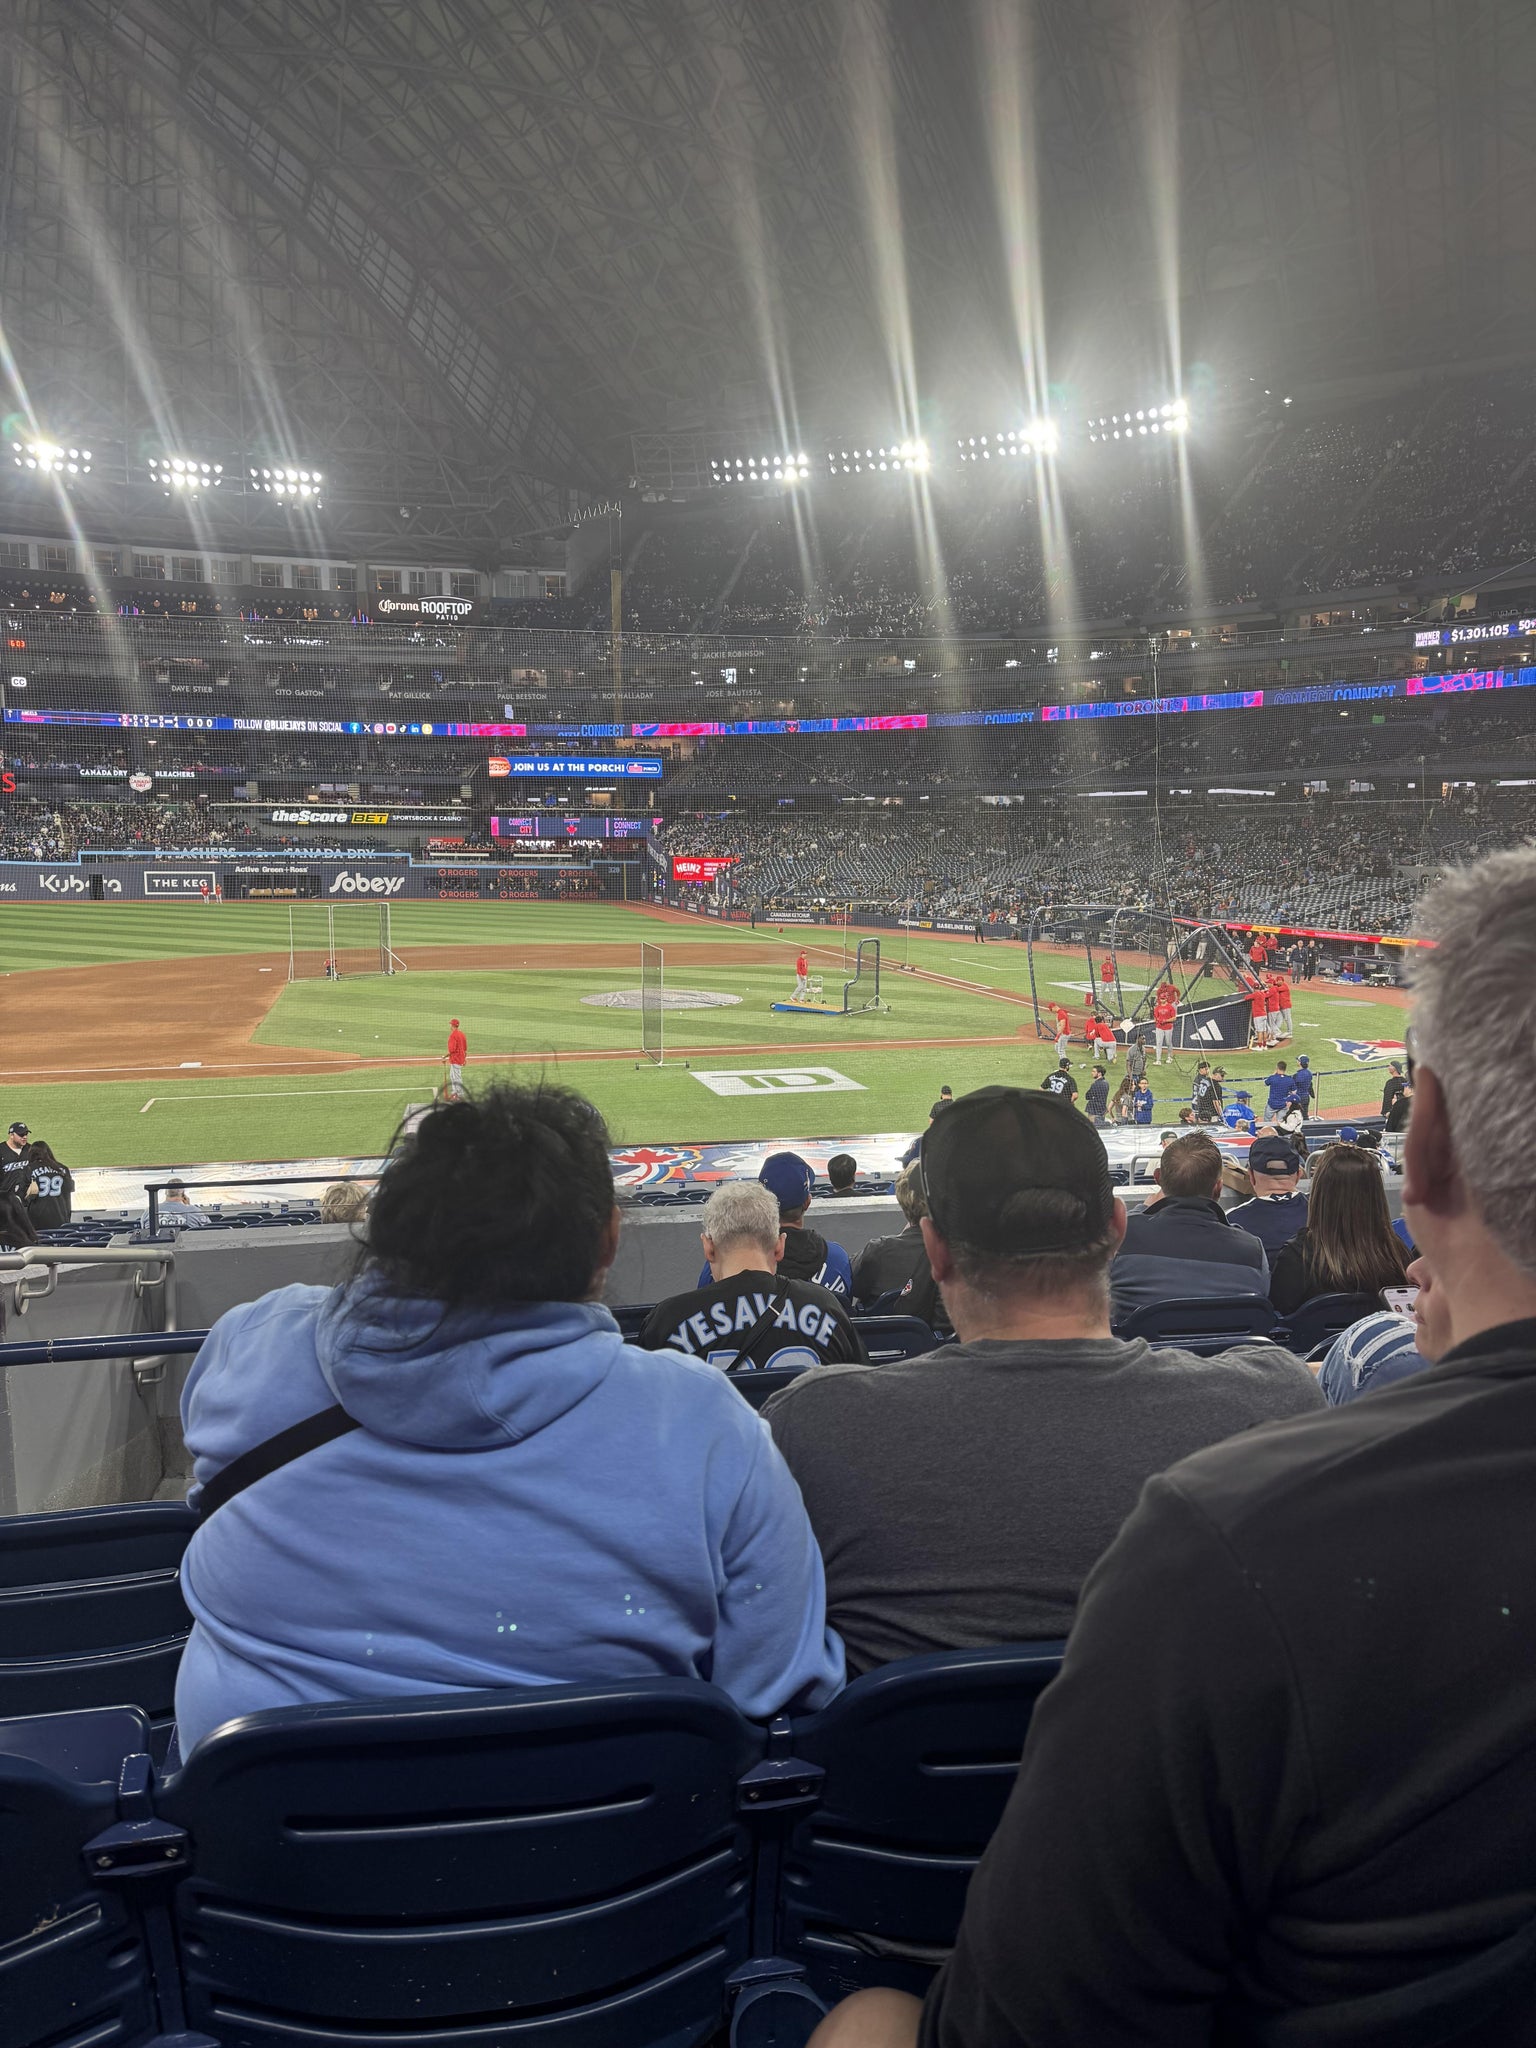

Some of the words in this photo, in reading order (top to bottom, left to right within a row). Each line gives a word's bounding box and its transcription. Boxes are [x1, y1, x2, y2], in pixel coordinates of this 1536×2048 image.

[378, 599, 419, 613] Corona
[421, 601, 472, 615] ROOFTOP
[1416, 631, 1440, 641] WINNER
[1451, 624, 1510, 642] $1,301,105
[702, 651, 726, 659] JACKIE
[728, 649, 764, 658] ROBINSON
[295, 689, 324, 697] GASTON
[727, 689, 762, 697] BAUTISTA
[1333, 685, 1396, 702] CONNECT
[187, 718, 193, 727] 0
[196, 719, 203, 728] 0
[206, 719, 213, 728] 0
[233, 718, 263, 730] FOLLOW
[264, 720, 306, 732] @BLUEJAYS
[307, 721, 318, 732] ON
[318, 721, 343, 732] SOCIAL
[581, 724, 625, 737] CONNECT
[513, 762, 535, 772] JOIN
[537, 762, 550, 772] US
[552, 763, 565, 772] AT
[567, 763, 585, 772] THE
[79, 768, 112, 777] CANADA
[112, 769, 128, 777] DRY
[155, 770, 195, 778] BLEACHERS
[271, 810, 348, 823] theScore
[352, 814, 387, 823] BET
[392, 814, 432, 822] SPORTSBOOK
[508, 818, 533, 826] CONNECT
[613, 822, 642, 830] CONNECT
[520, 826, 533, 834] CITY
[613, 829, 628, 837] CITY
[508, 869, 538, 877] ROGERS
[676, 863, 701, 874] HEINZ
[153, 878, 179, 888] THE
[183, 879, 208, 888] KEG
[329, 870, 405, 895] Sobeys
[1050, 1080, 1064, 1094] 39
[38, 1175, 64, 1198] 39
[668, 1292, 838, 1355] YESAVAGE
